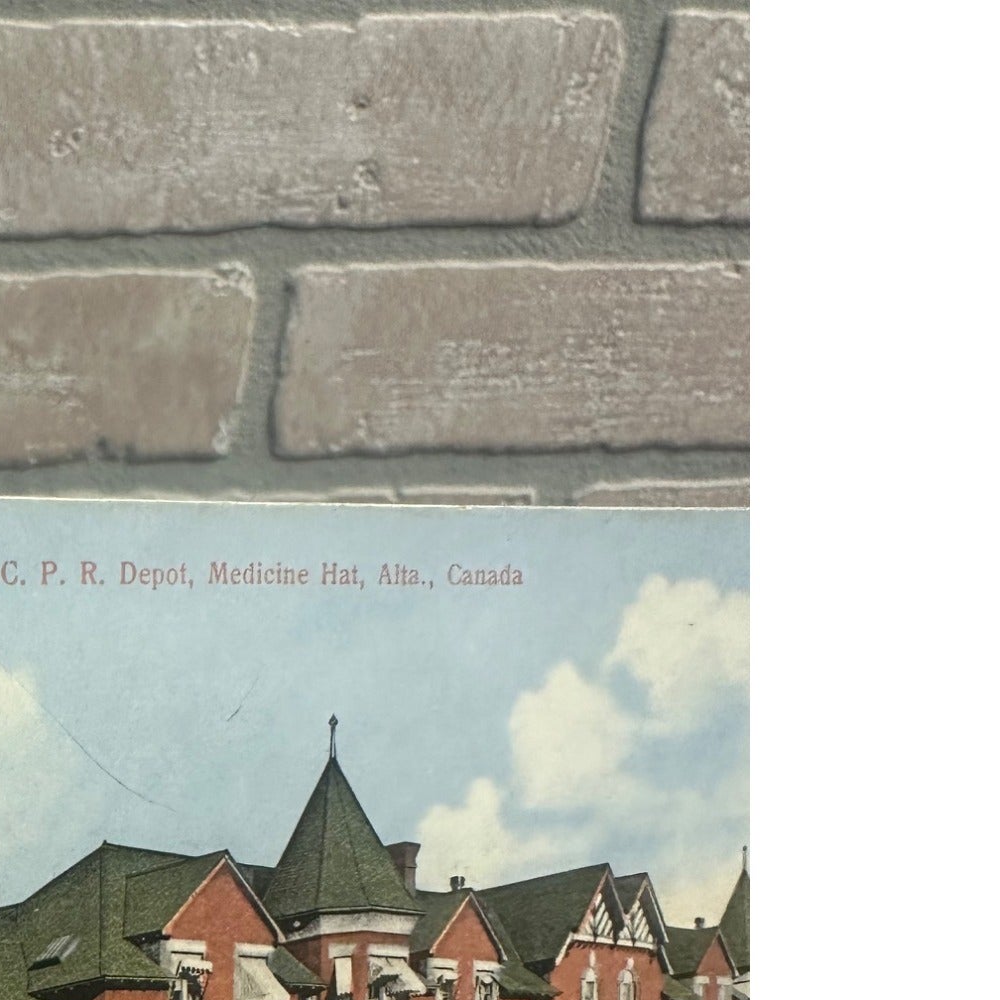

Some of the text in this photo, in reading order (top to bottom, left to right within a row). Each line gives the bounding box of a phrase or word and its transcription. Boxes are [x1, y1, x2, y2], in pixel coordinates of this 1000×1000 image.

[0, 560, 524, 591] C. P. R. Depot, Medicine Hat, Alta., Canada
